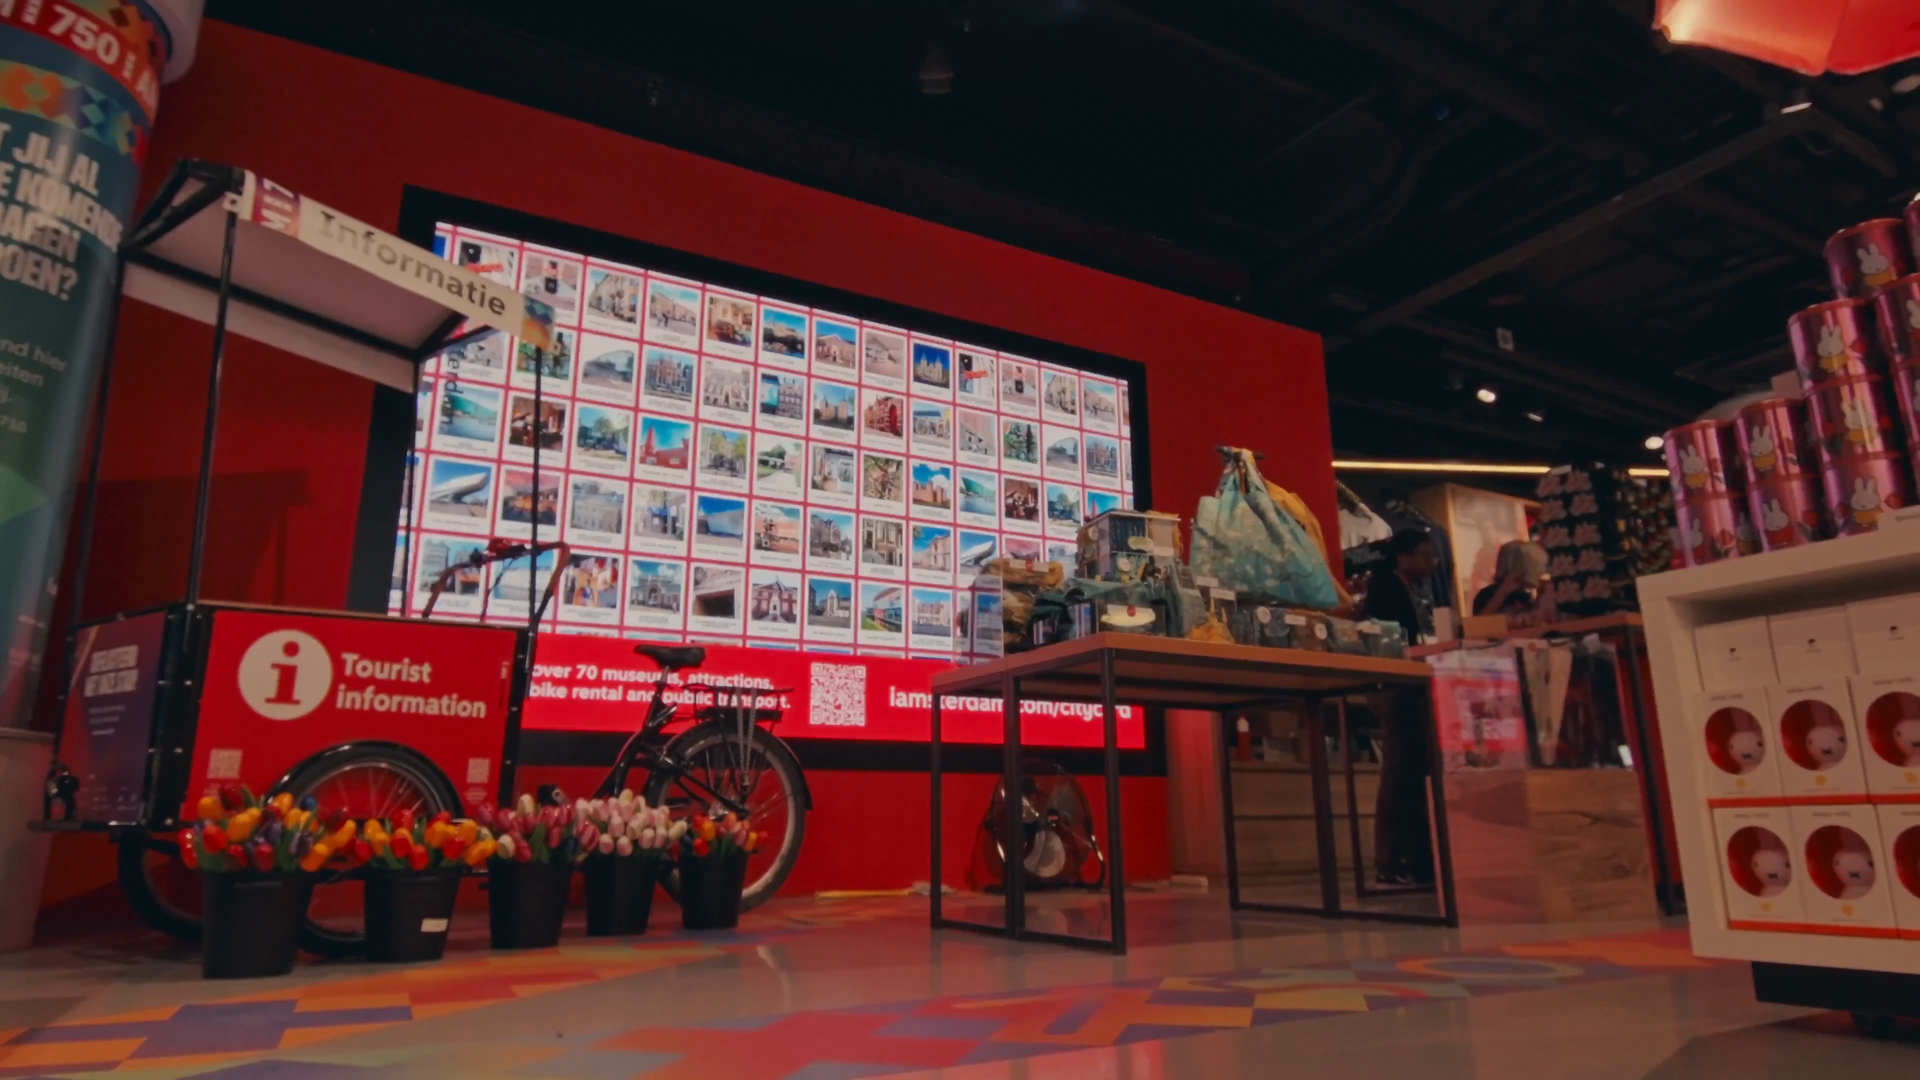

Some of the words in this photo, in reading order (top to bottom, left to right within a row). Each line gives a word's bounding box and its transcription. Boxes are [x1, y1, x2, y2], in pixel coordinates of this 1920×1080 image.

[48, 4, 121, 65] 750
[69, 154, 100, 196] AL
[317, 210, 507, 316] Informatie
[341, 651, 432, 684] Tourist
[532, 664, 571, 679] over
[576, 664, 597, 681] 70
[335, 685, 488, 719] information
[530, 682, 567, 699] bike
[572, 684, 623, 702] rental
